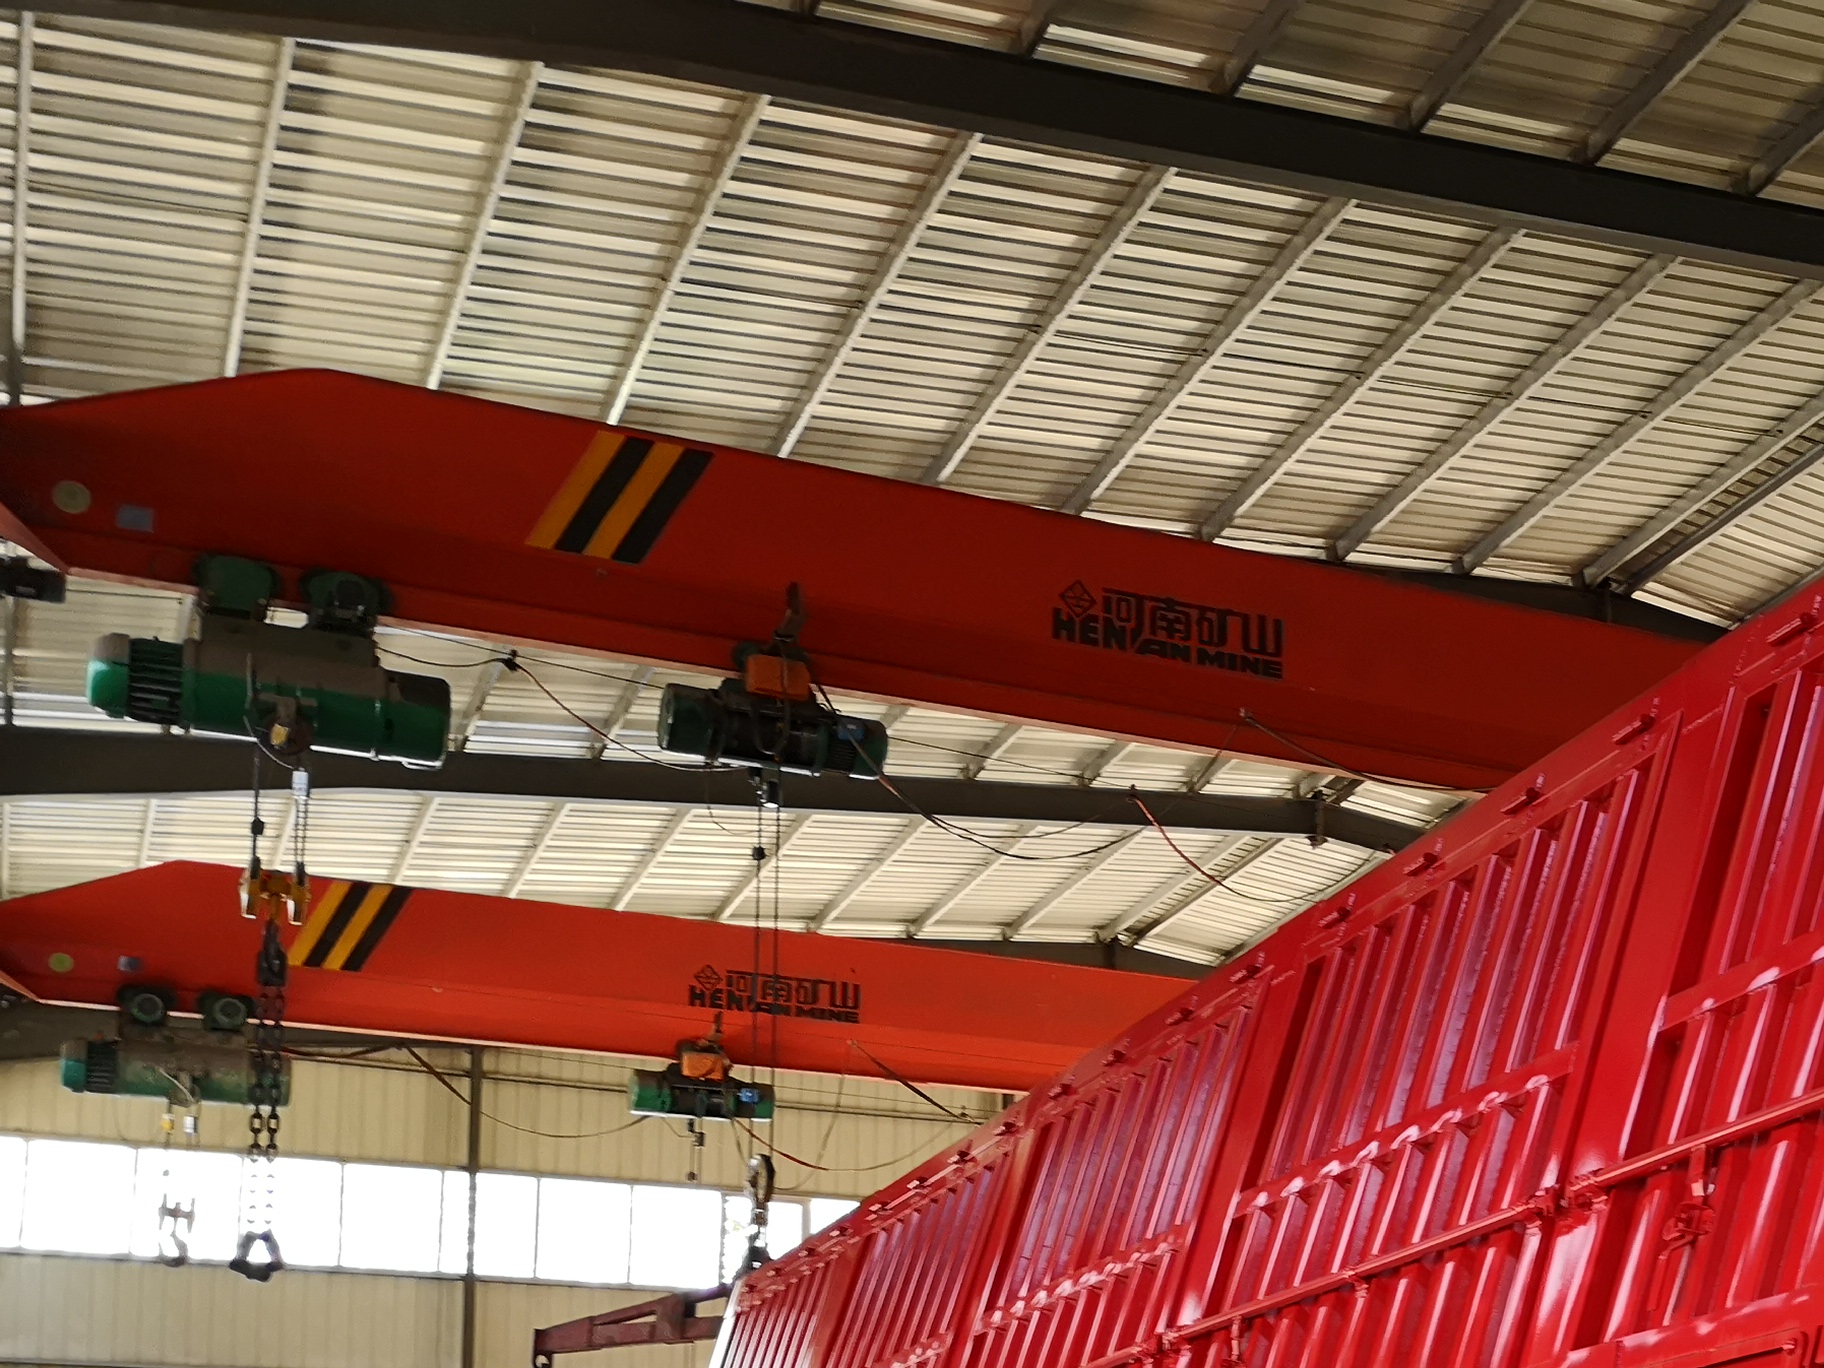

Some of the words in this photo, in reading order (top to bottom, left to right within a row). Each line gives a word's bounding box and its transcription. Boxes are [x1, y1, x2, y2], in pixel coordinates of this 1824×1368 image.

[1052, 607, 1191, 663] HENAN
[1196, 646, 1284, 679] MINE
[688, 984, 792, 1016] HENAN
[795, 1006, 860, 1023] MINE
